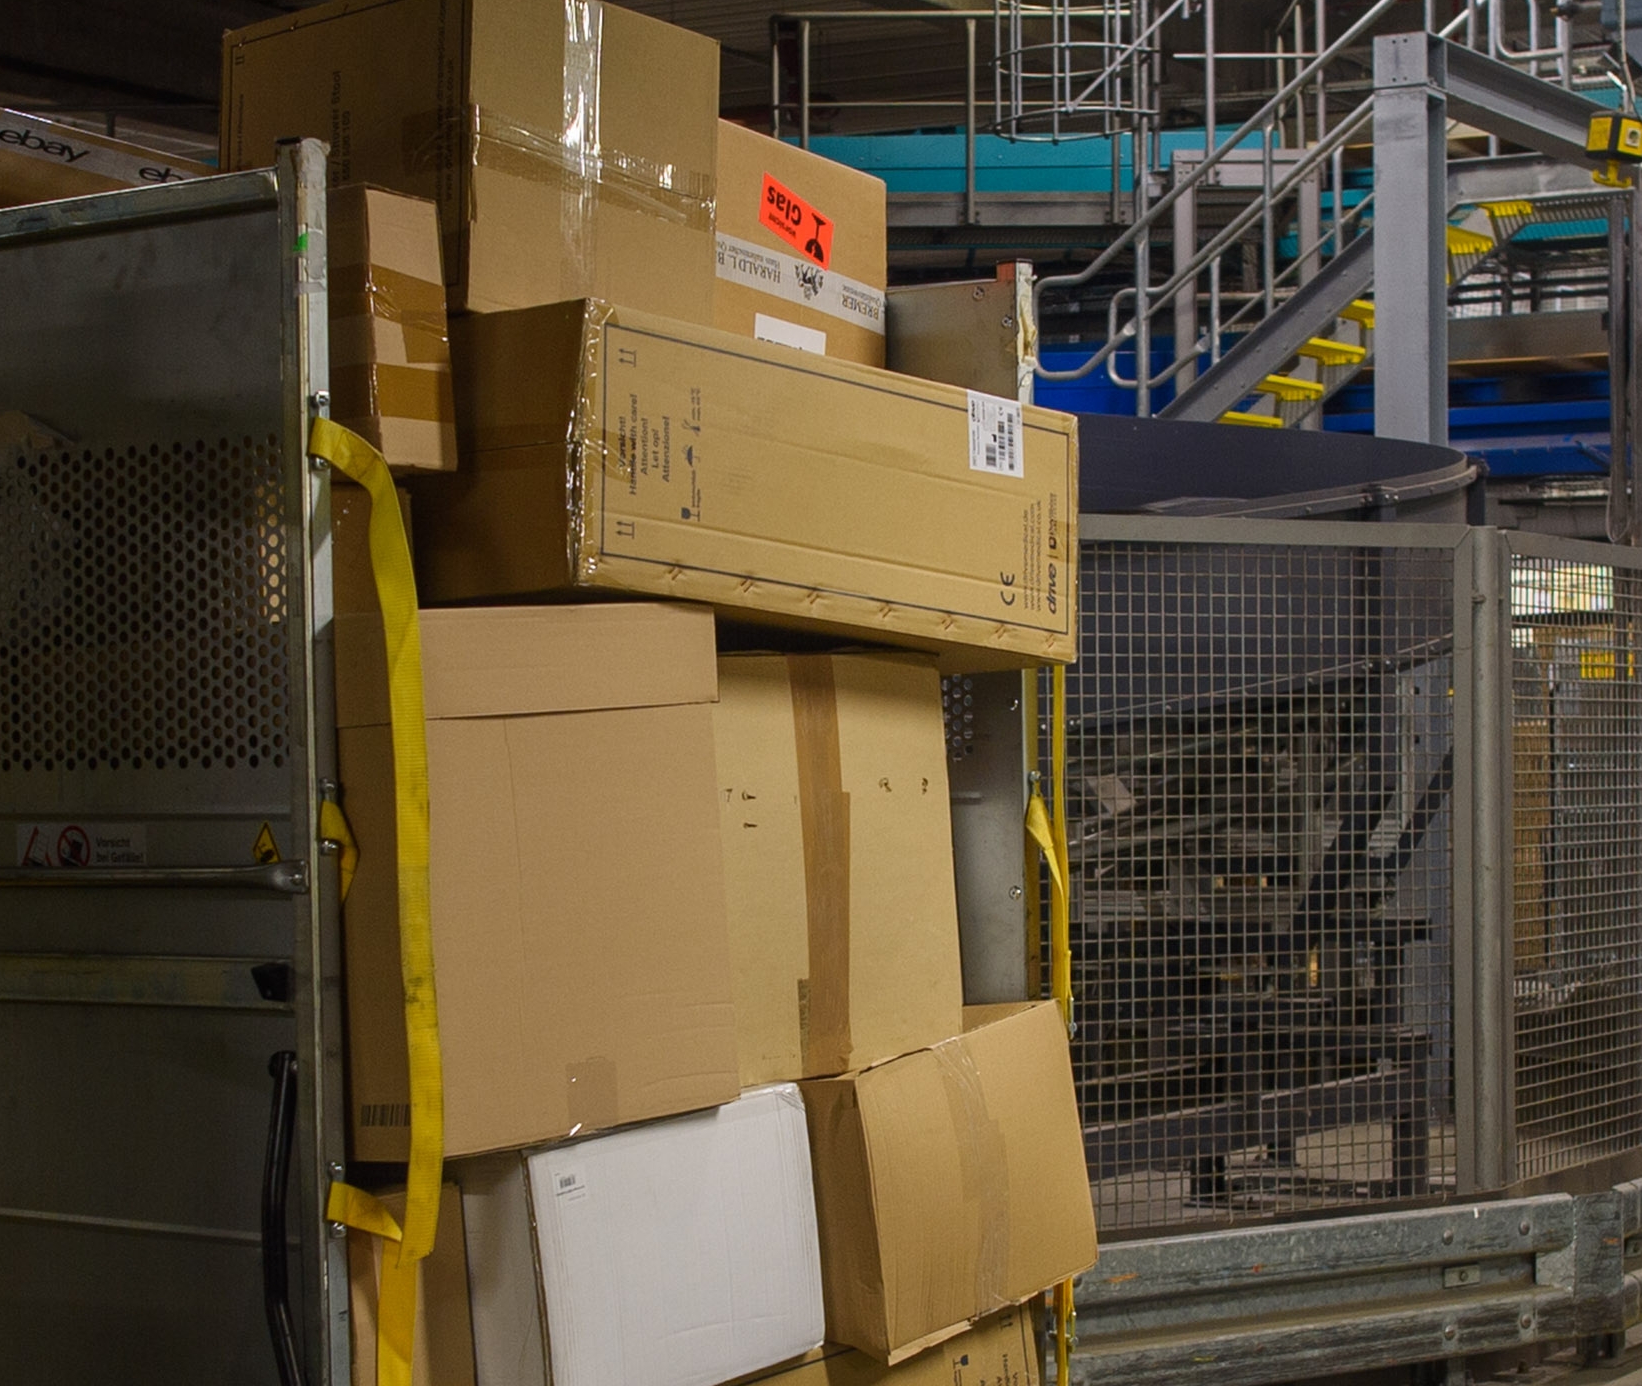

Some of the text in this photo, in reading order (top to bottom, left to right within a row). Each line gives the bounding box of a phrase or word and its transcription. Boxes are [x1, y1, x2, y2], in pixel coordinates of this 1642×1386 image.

[138, 166, 187, 184] eb
[766, 185, 802, 226] Glas
[717, 253, 726, 265] B
[738, 256, 781, 283] HARALD
[842, 295, 880, 321] BREMER
[630, 394, 638, 423] care!
[640, 418, 648, 475] Attention!
[651, 428, 660, 469] Let op!
[662, 416, 670, 483] Attenzione!
[1046, 563, 1057, 614] drive
